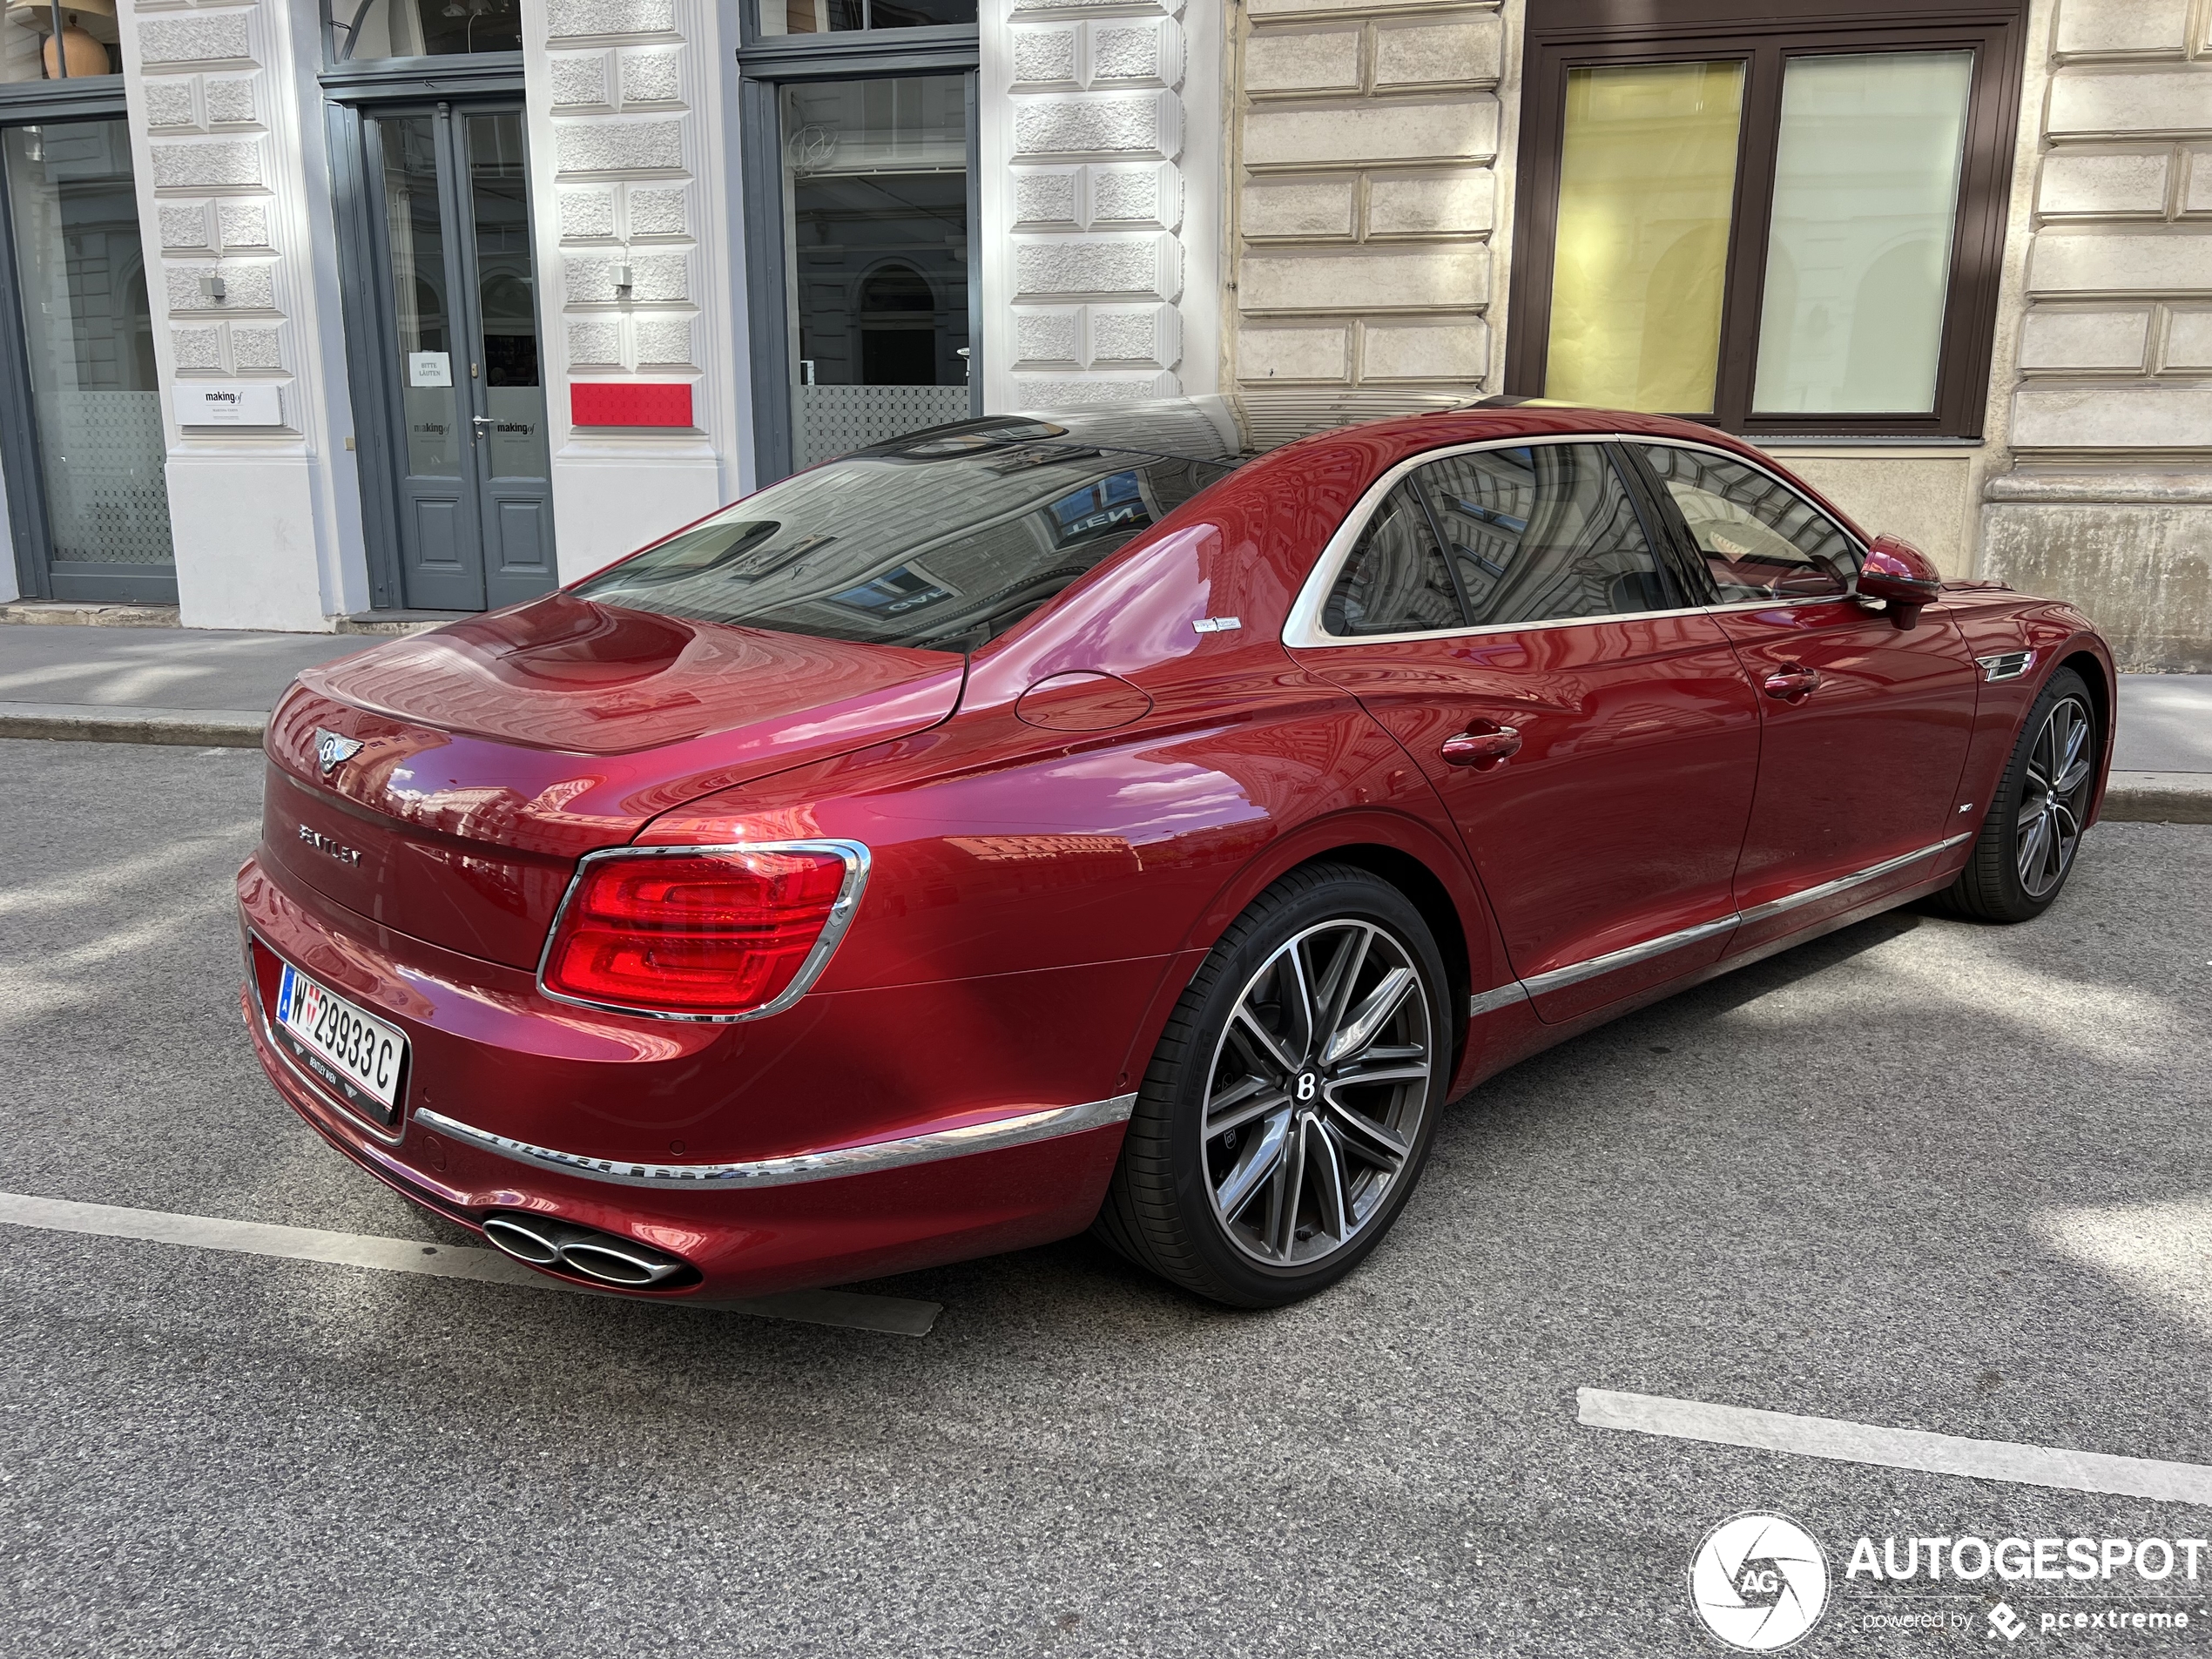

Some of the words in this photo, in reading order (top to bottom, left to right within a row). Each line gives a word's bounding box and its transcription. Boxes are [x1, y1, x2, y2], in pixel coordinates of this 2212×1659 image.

[300, 824, 361, 867] BENTLEY
[281, 999, 288, 1014] A
[292, 975, 307, 1024] W
[309, 1056, 326, 1076] BENTLEY
[326, 1069, 336, 1085] WIEN
[1297, 1073, 1315, 1101] B
